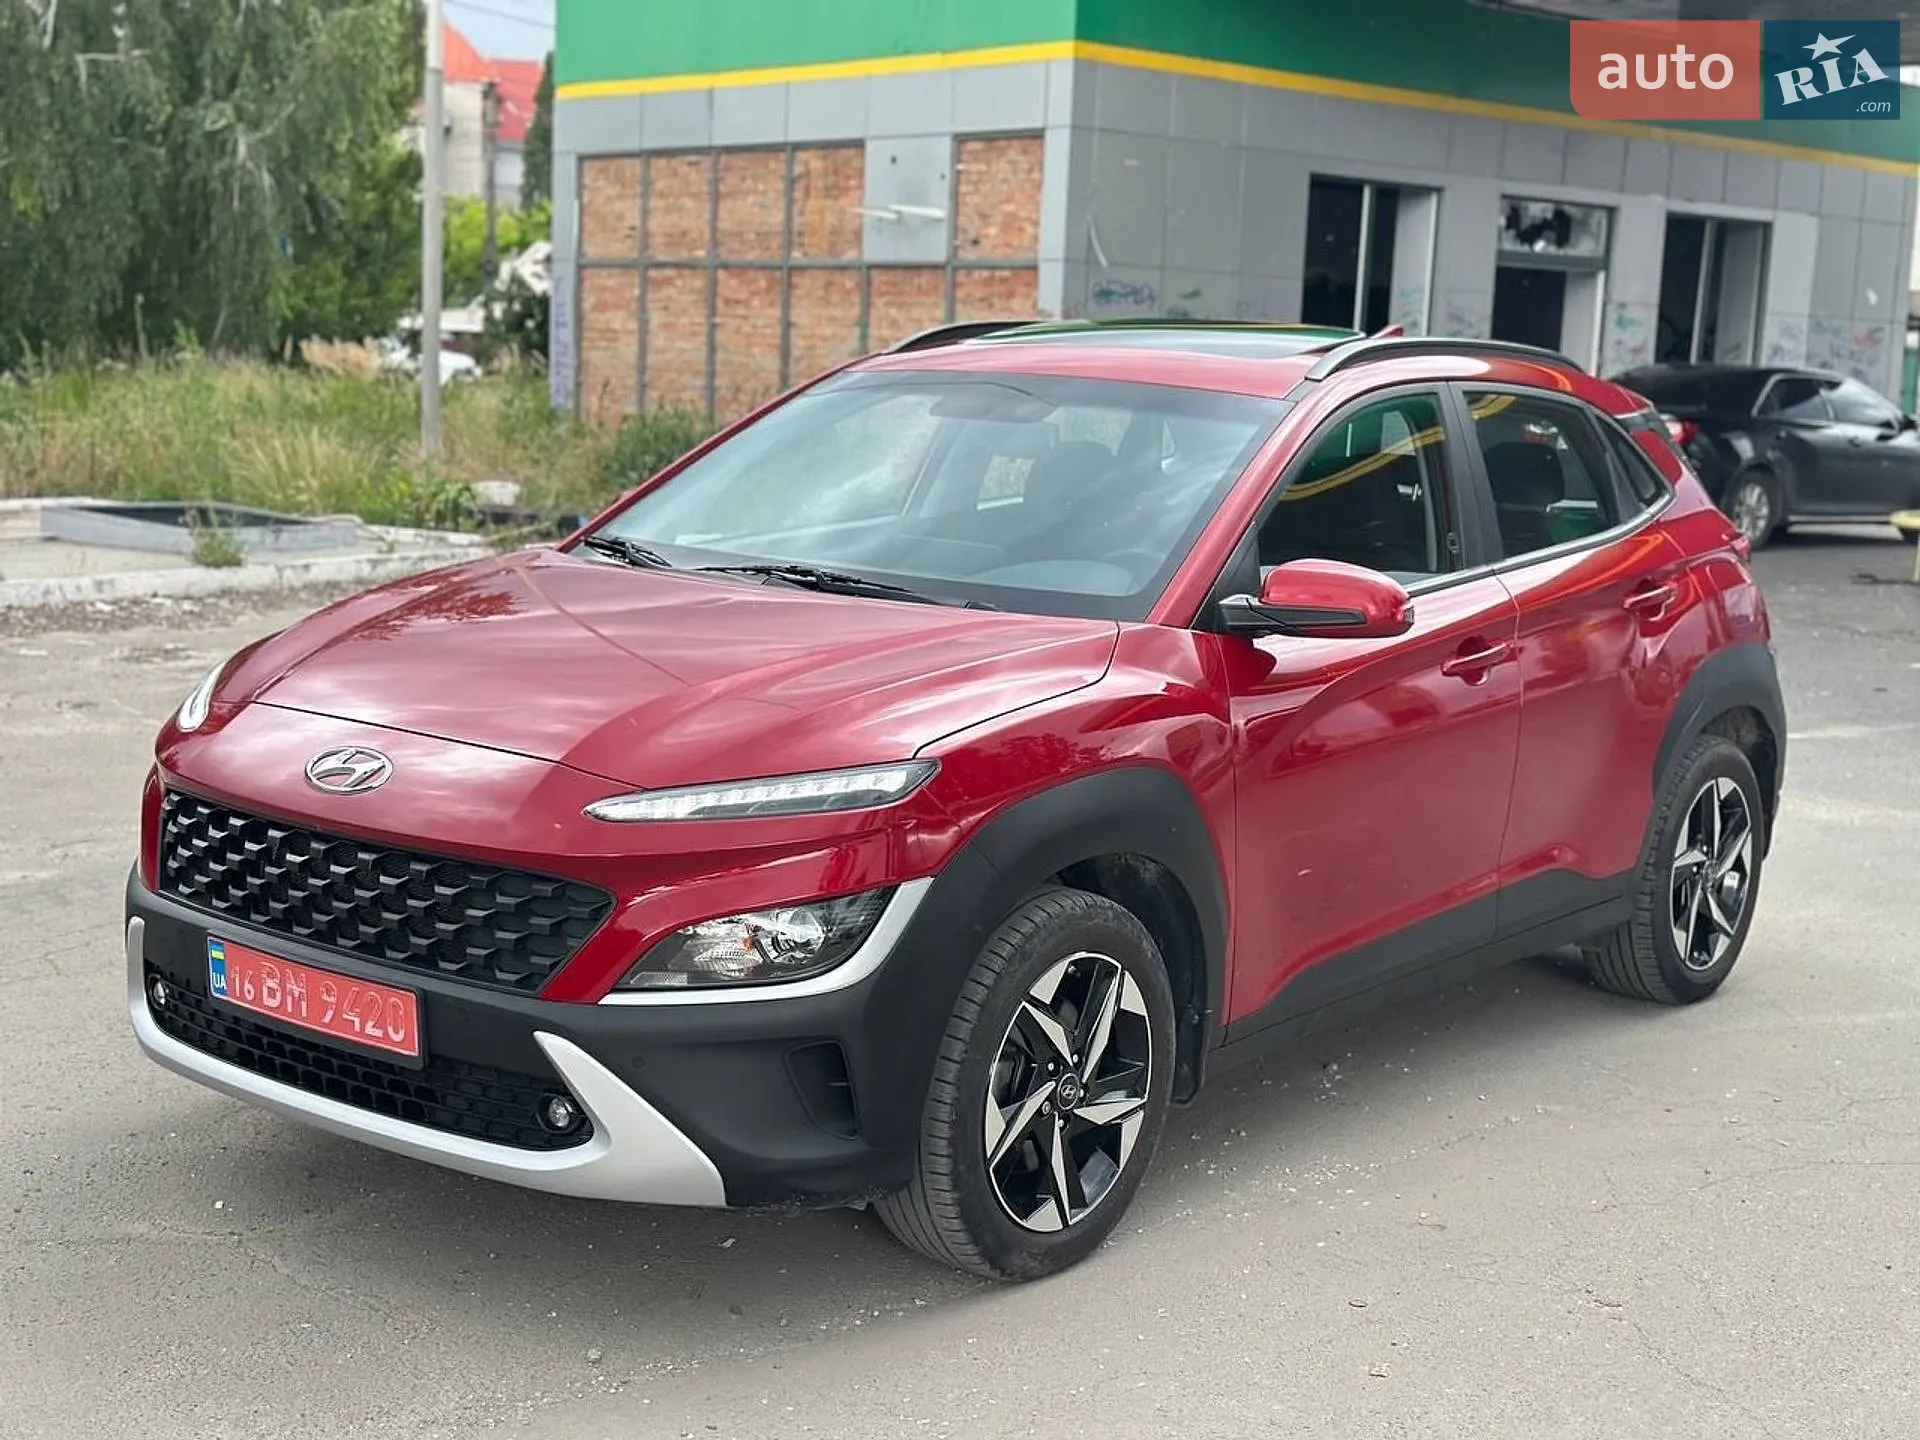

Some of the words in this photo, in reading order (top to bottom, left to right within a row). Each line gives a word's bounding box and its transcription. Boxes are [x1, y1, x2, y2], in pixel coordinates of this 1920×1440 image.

[213, 972, 228, 990] UA
[230, 965, 255, 1001] 16
[260, 961, 308, 1018] BM
[319, 980, 405, 1043] 9420
